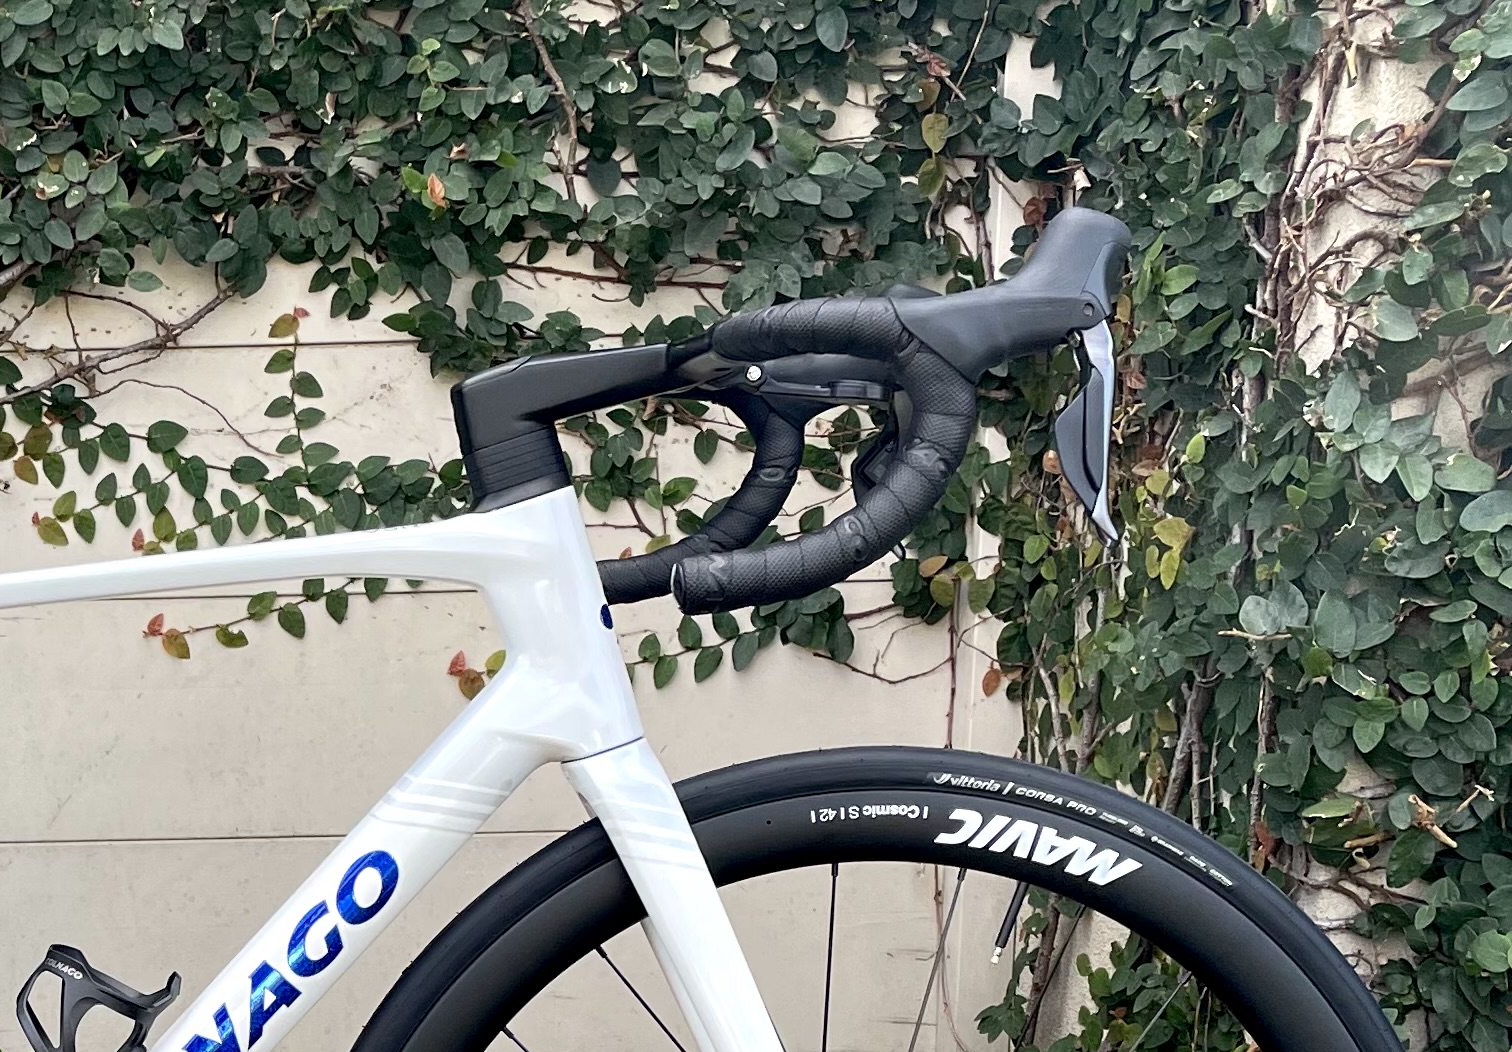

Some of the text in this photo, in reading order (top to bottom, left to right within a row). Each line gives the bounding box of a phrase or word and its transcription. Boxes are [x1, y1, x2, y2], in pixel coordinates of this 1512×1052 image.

[818, 804, 920, 822] Cosmic S 42
[950, 775, 1001, 793] vittoria
[1066, 800, 1097, 816] PRO
[933, 808, 1143, 887] MAVIC
